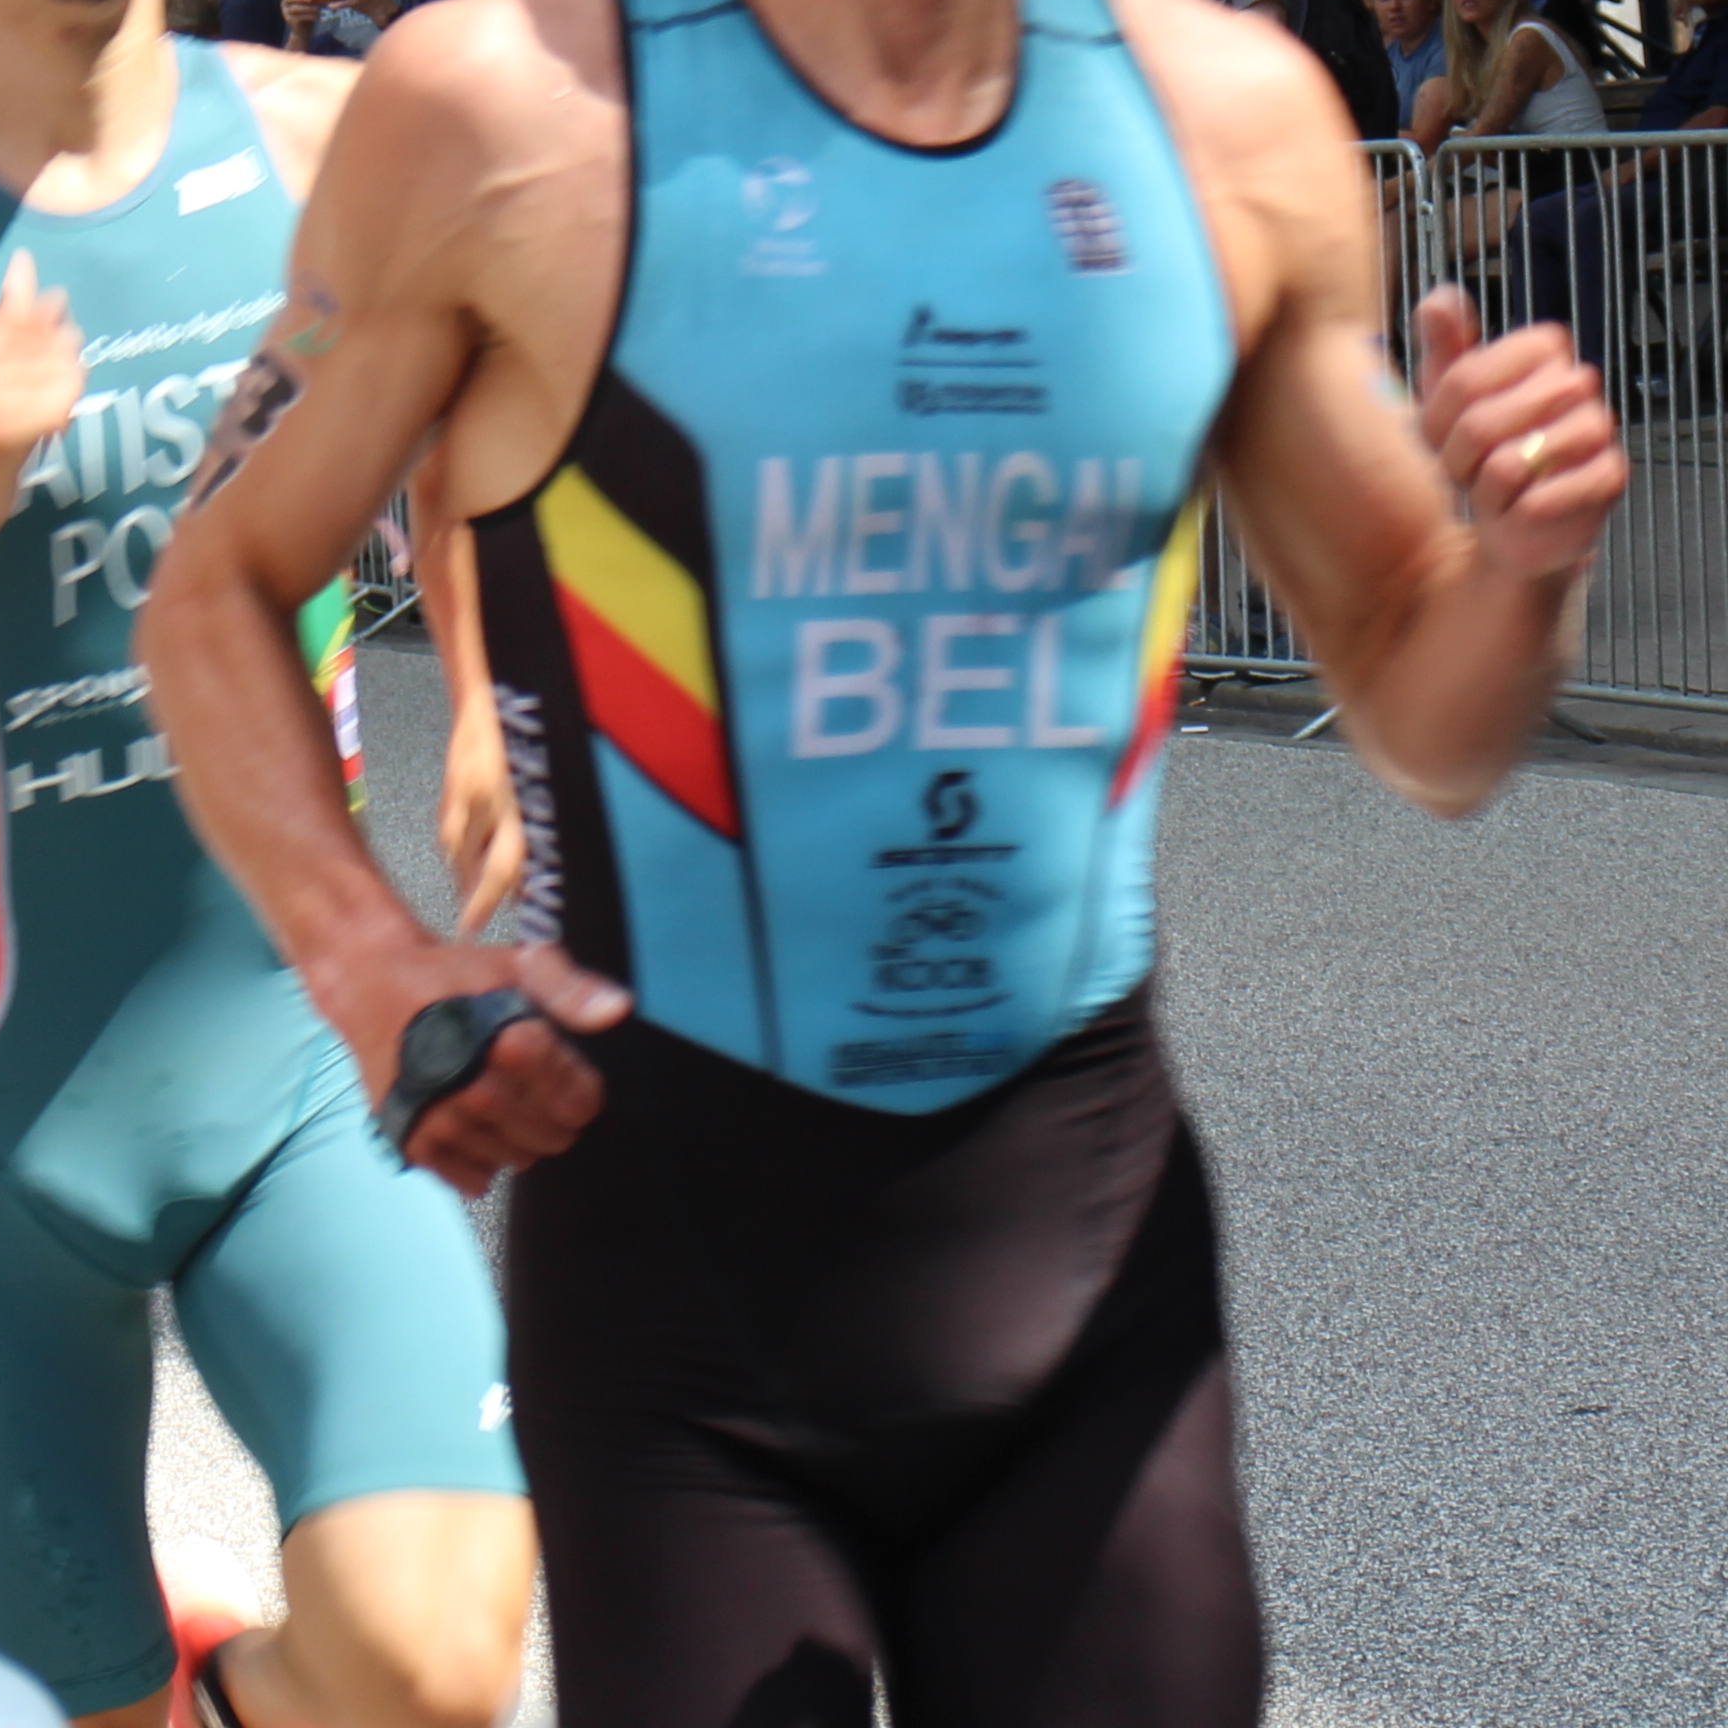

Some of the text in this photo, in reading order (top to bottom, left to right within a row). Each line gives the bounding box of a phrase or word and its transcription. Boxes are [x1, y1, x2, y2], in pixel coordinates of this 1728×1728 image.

[50, 502, 176, 628] PO
[750, 450, 1144, 600] MENGAL
[790, 613, 1108, 760] BEL
